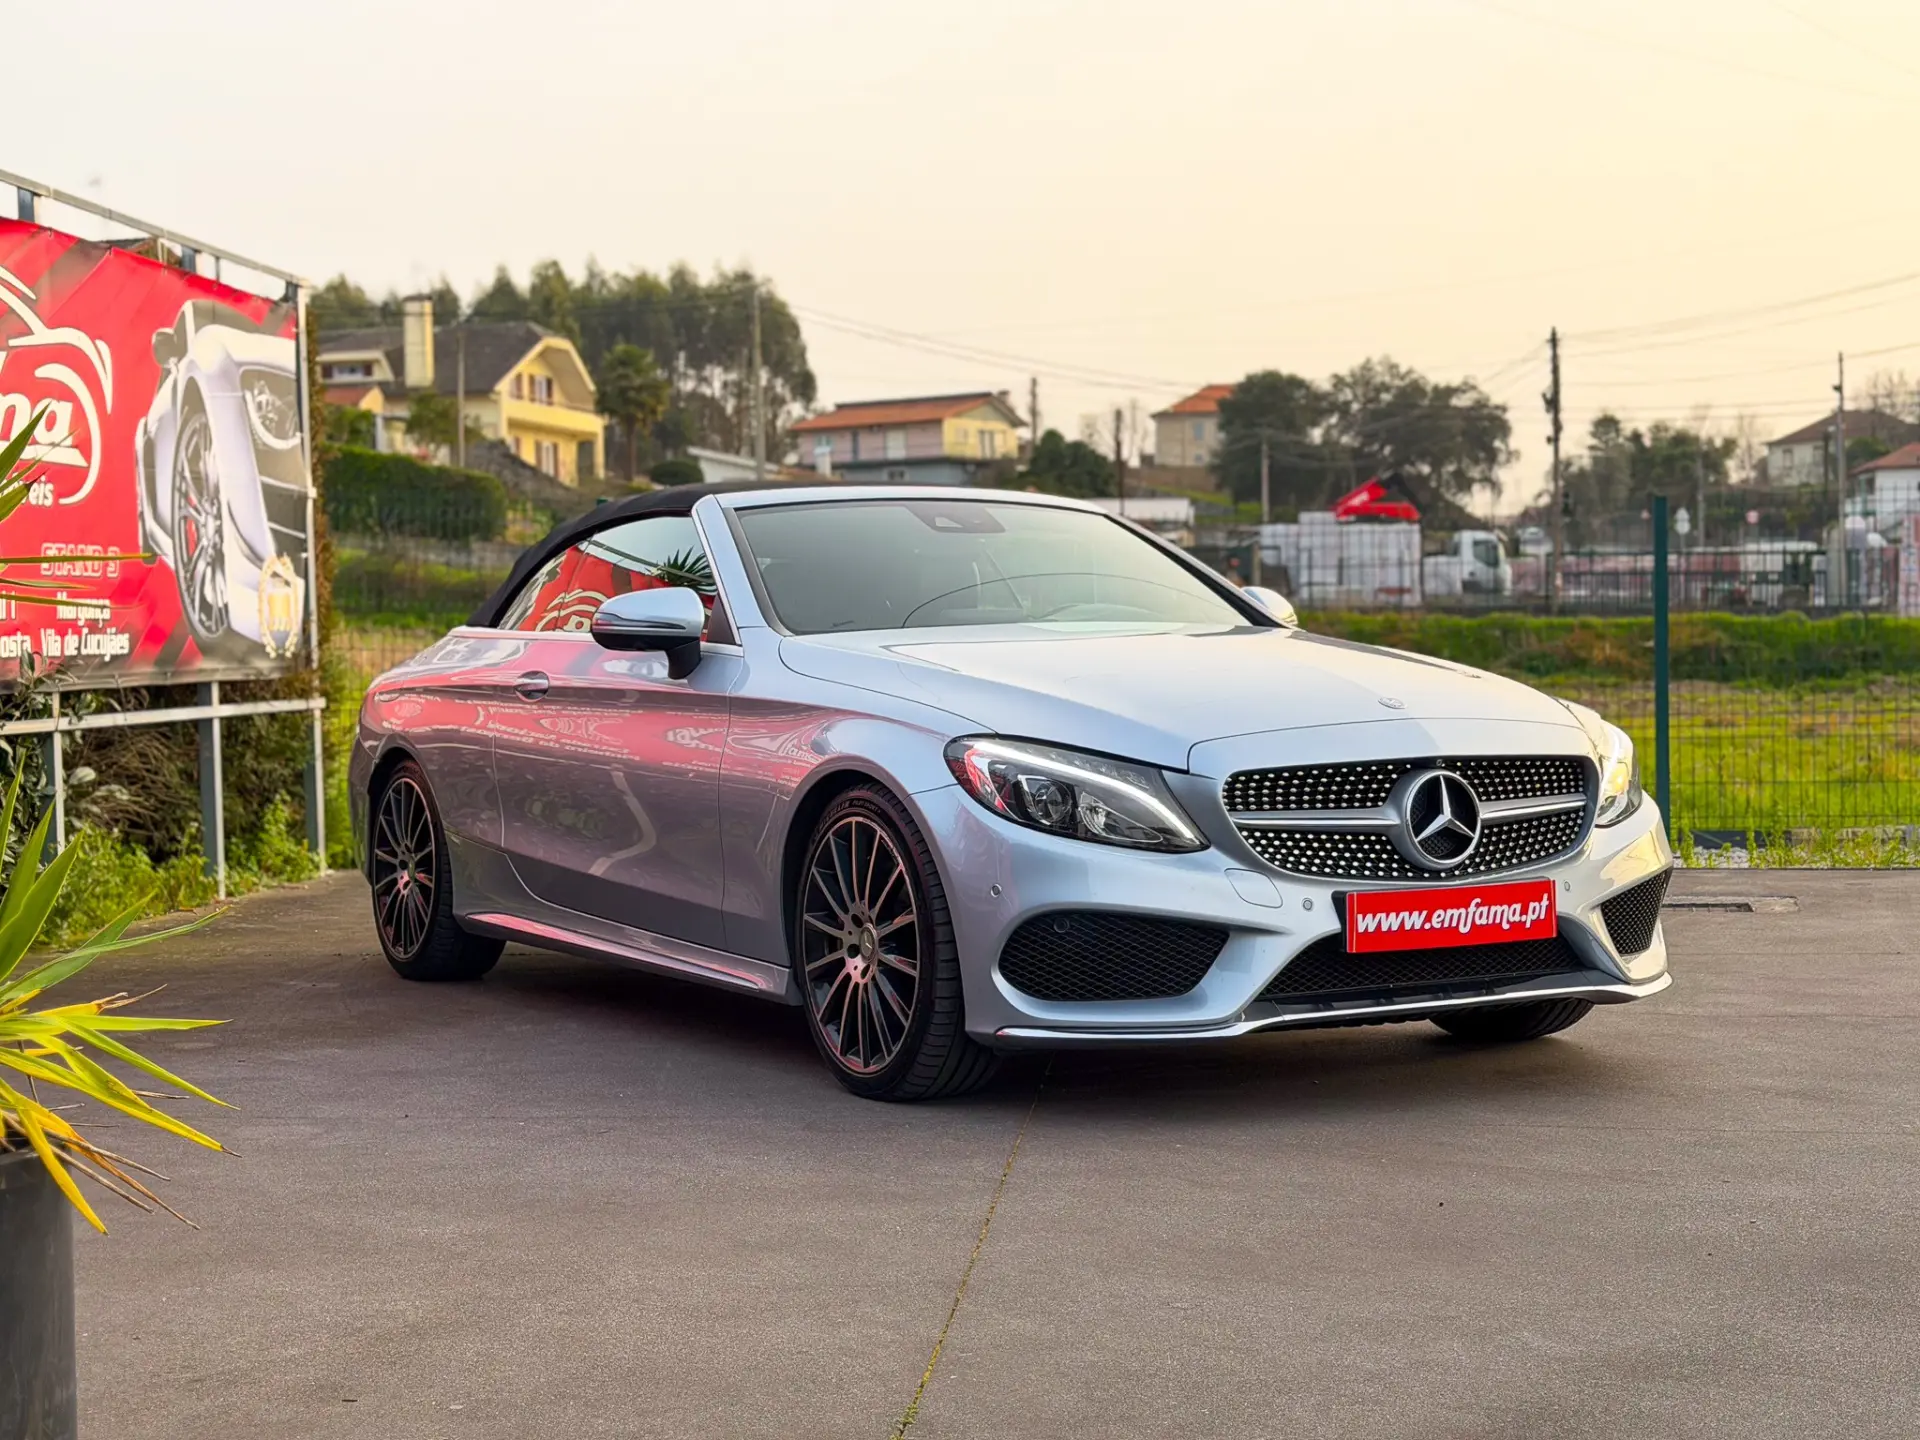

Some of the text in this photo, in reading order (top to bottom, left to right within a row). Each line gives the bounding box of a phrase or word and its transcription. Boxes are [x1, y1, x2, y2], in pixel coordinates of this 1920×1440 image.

[41, 543, 103, 576] STAND
[40, 628, 61, 658] Vila
[64, 628, 79, 656] de
[1357, 893, 1549, 933] www.emfama.pt
